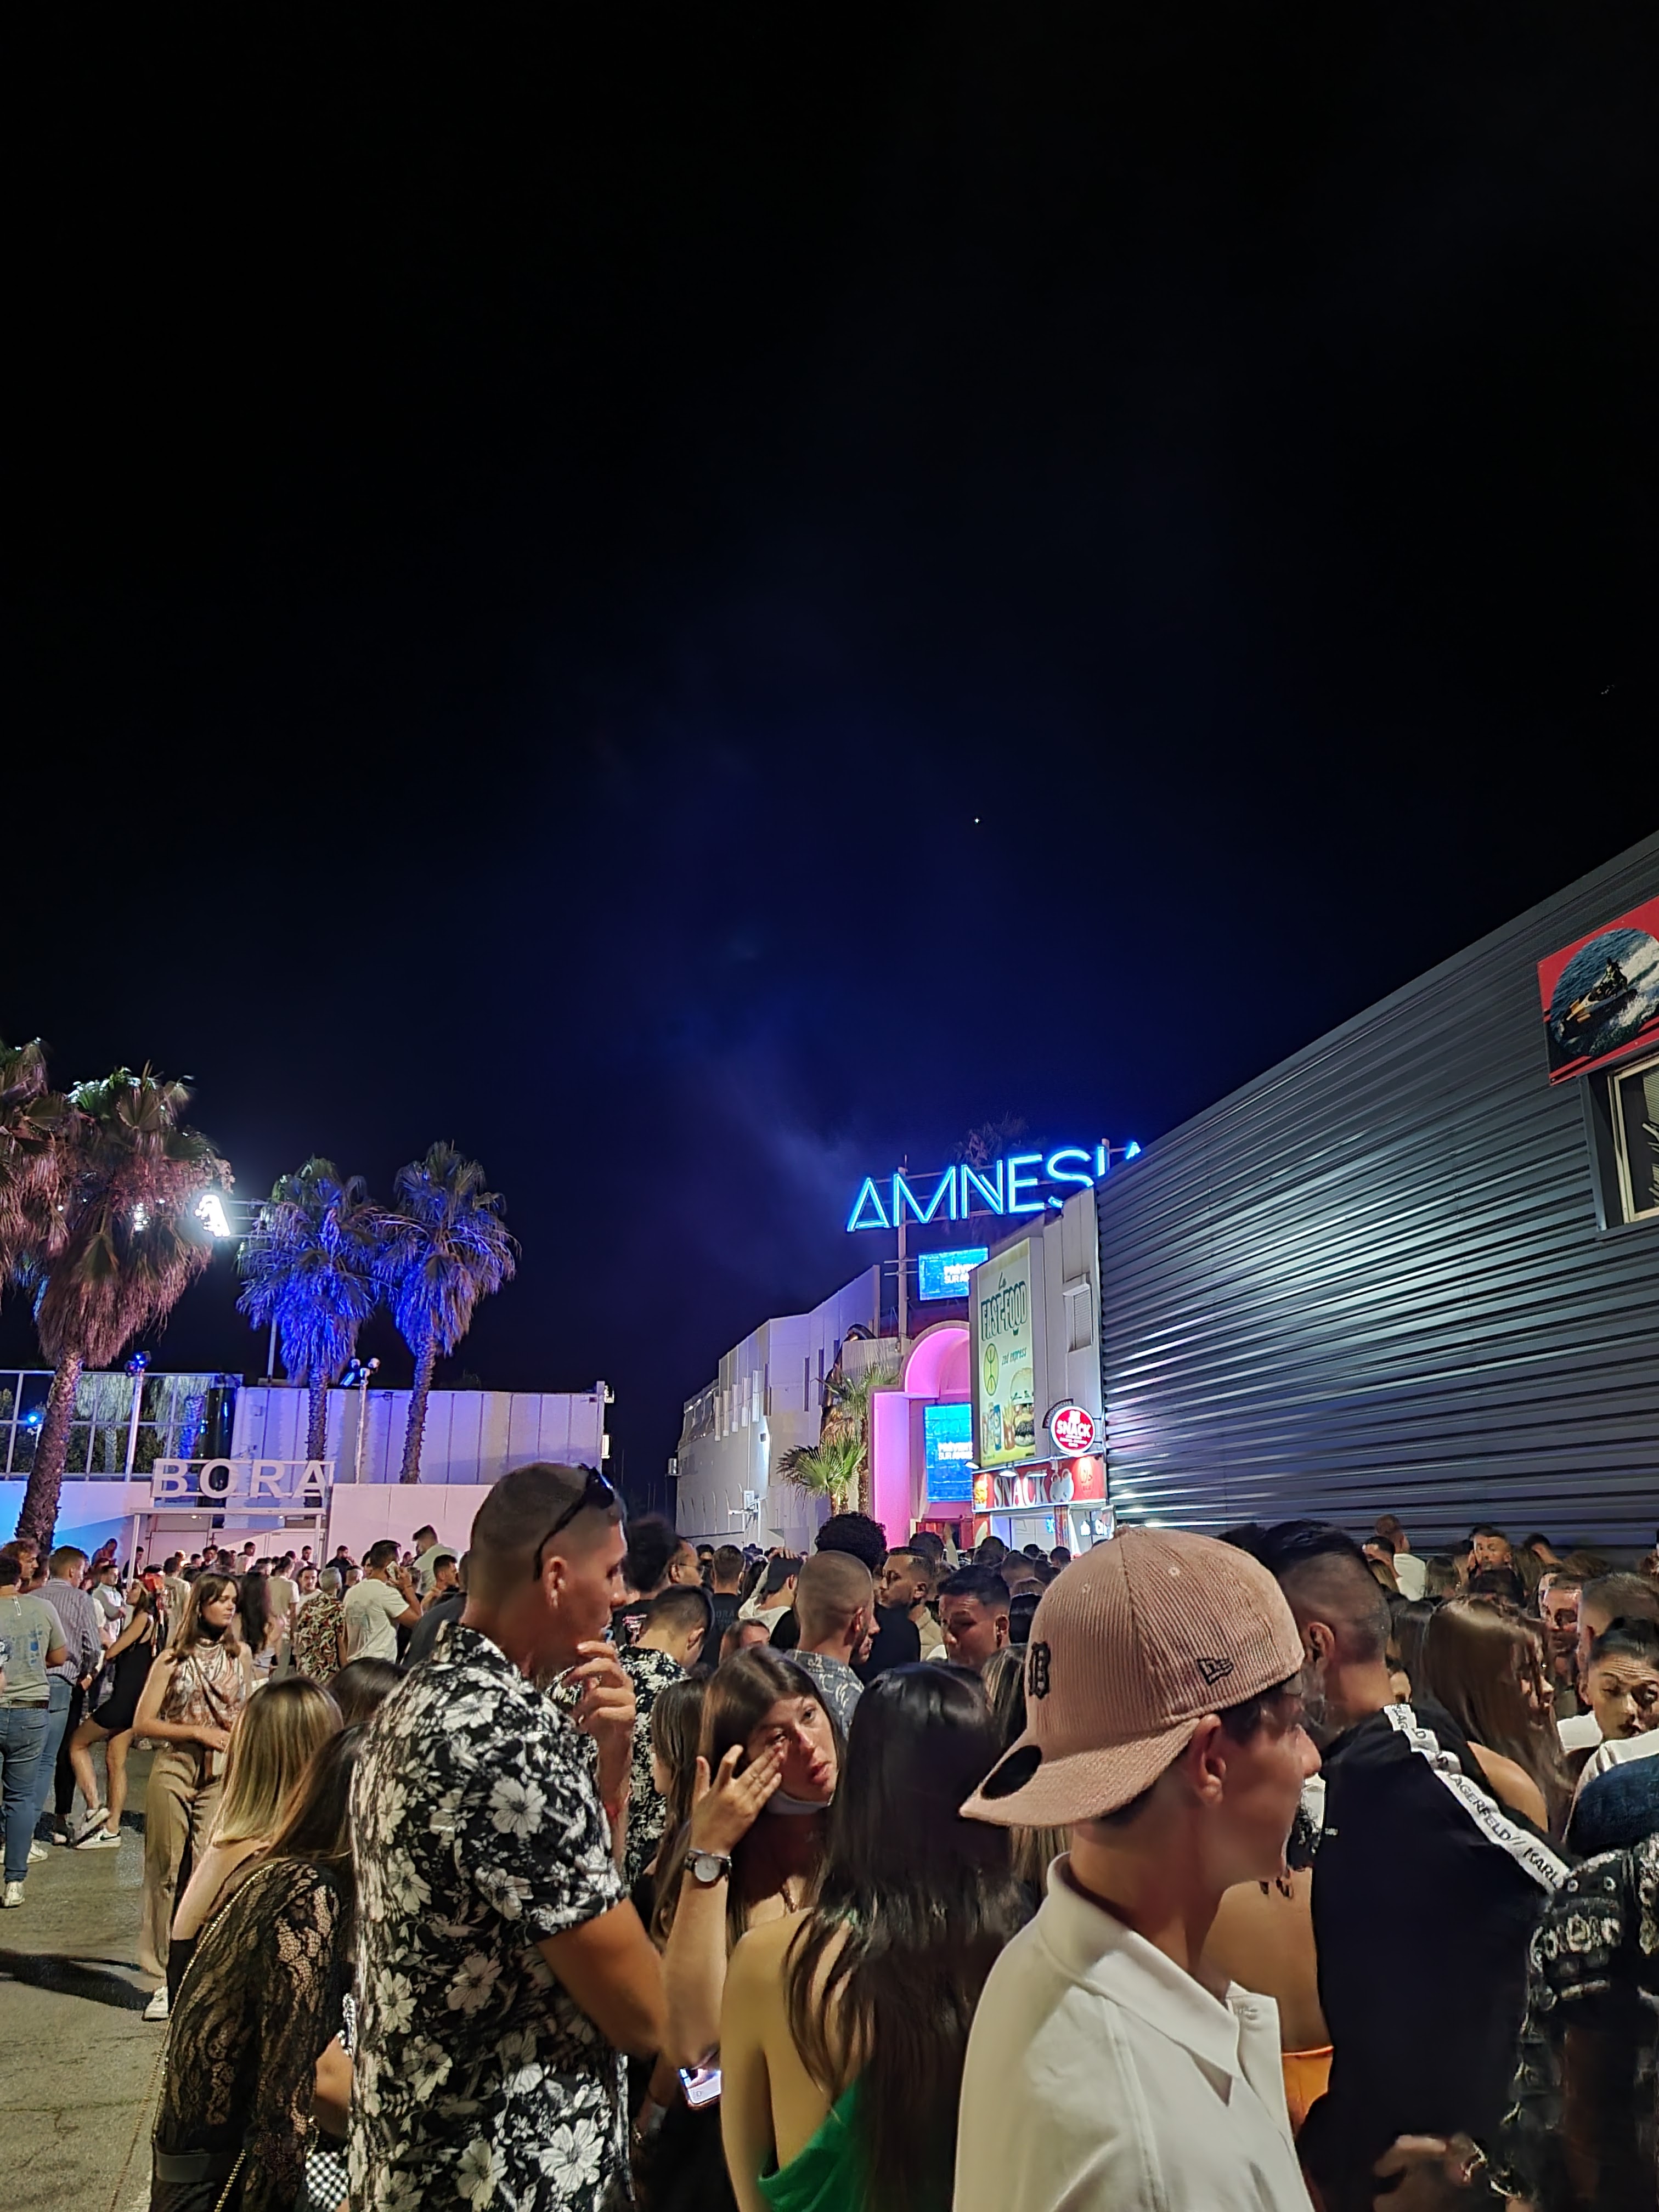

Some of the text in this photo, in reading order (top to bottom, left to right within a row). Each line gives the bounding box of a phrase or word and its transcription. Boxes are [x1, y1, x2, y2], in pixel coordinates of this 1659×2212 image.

[980, 1280, 1028, 1341] FAST-FOOD
[1056, 1419, 1092, 1438] SNACK
[150, 1458, 329, 1499] BORA
[994, 1469, 1049, 1509] SNACK
